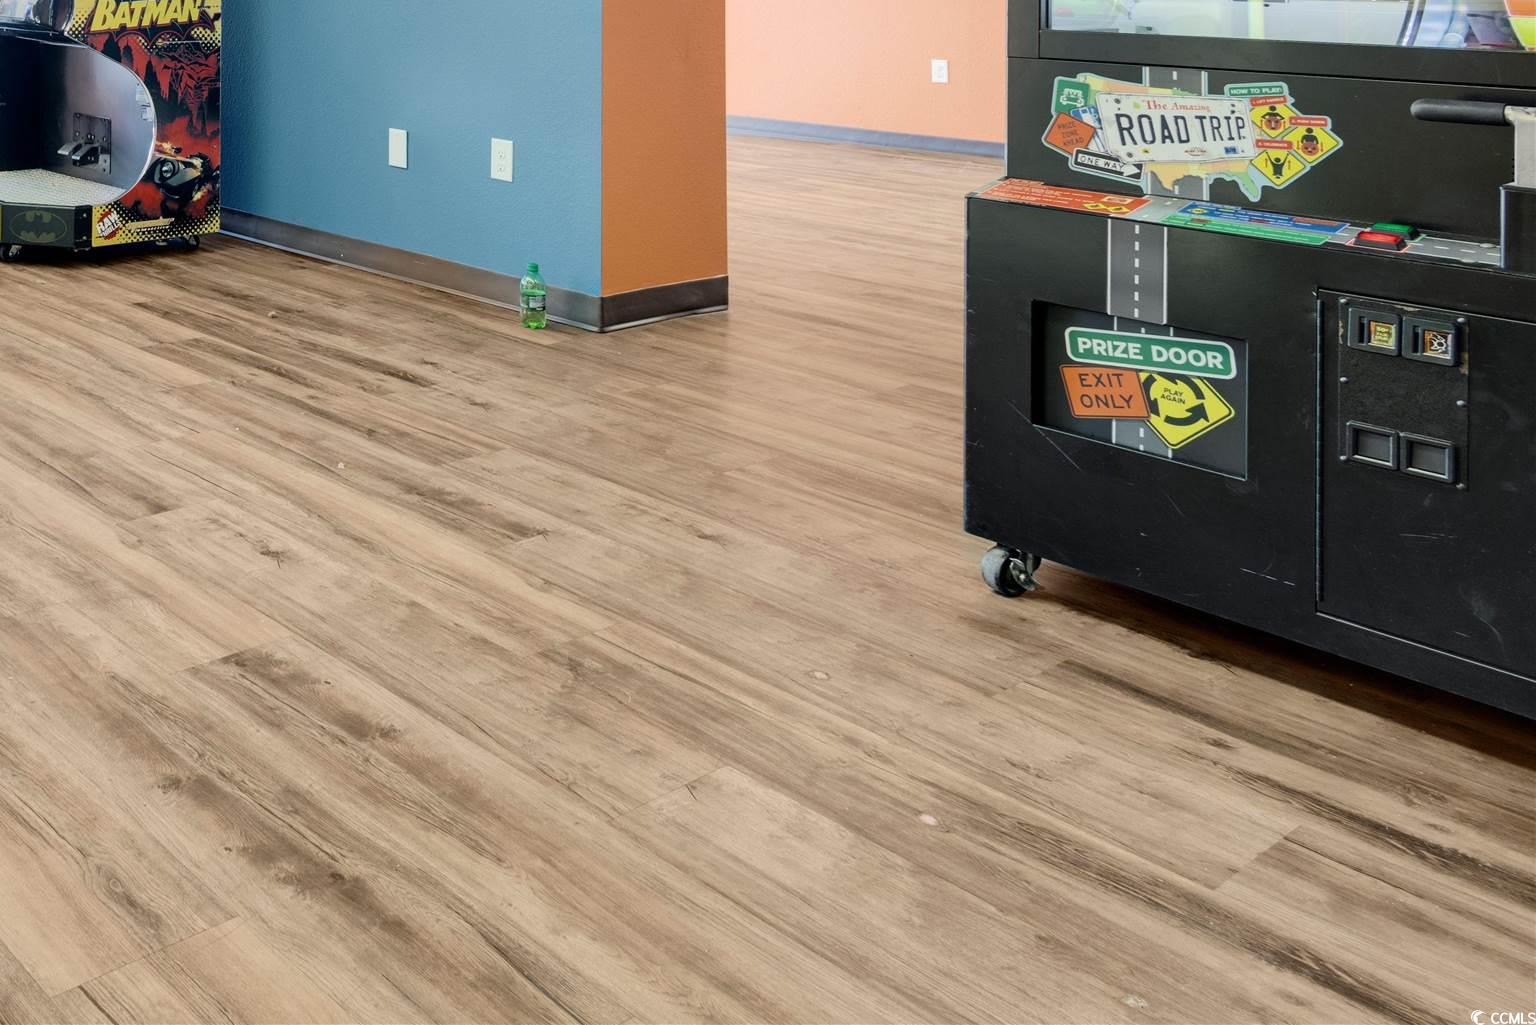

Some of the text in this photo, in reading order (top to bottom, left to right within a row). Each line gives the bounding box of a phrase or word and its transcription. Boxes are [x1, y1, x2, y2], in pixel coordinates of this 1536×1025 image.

[1146, 99, 1211, 113] The Amazing
[1114, 113, 1246, 146] ROAD TRIP
[1079, 154, 1124, 170] ONE WAY
[1076, 336, 1225, 370] PRIZE DOOR
[1078, 372, 1124, 388] EXIT
[1160, 393, 1187, 406] AGAIN
[1163, 387, 1184, 397] PLAY
[1079, 393, 1134, 409] ONLY
